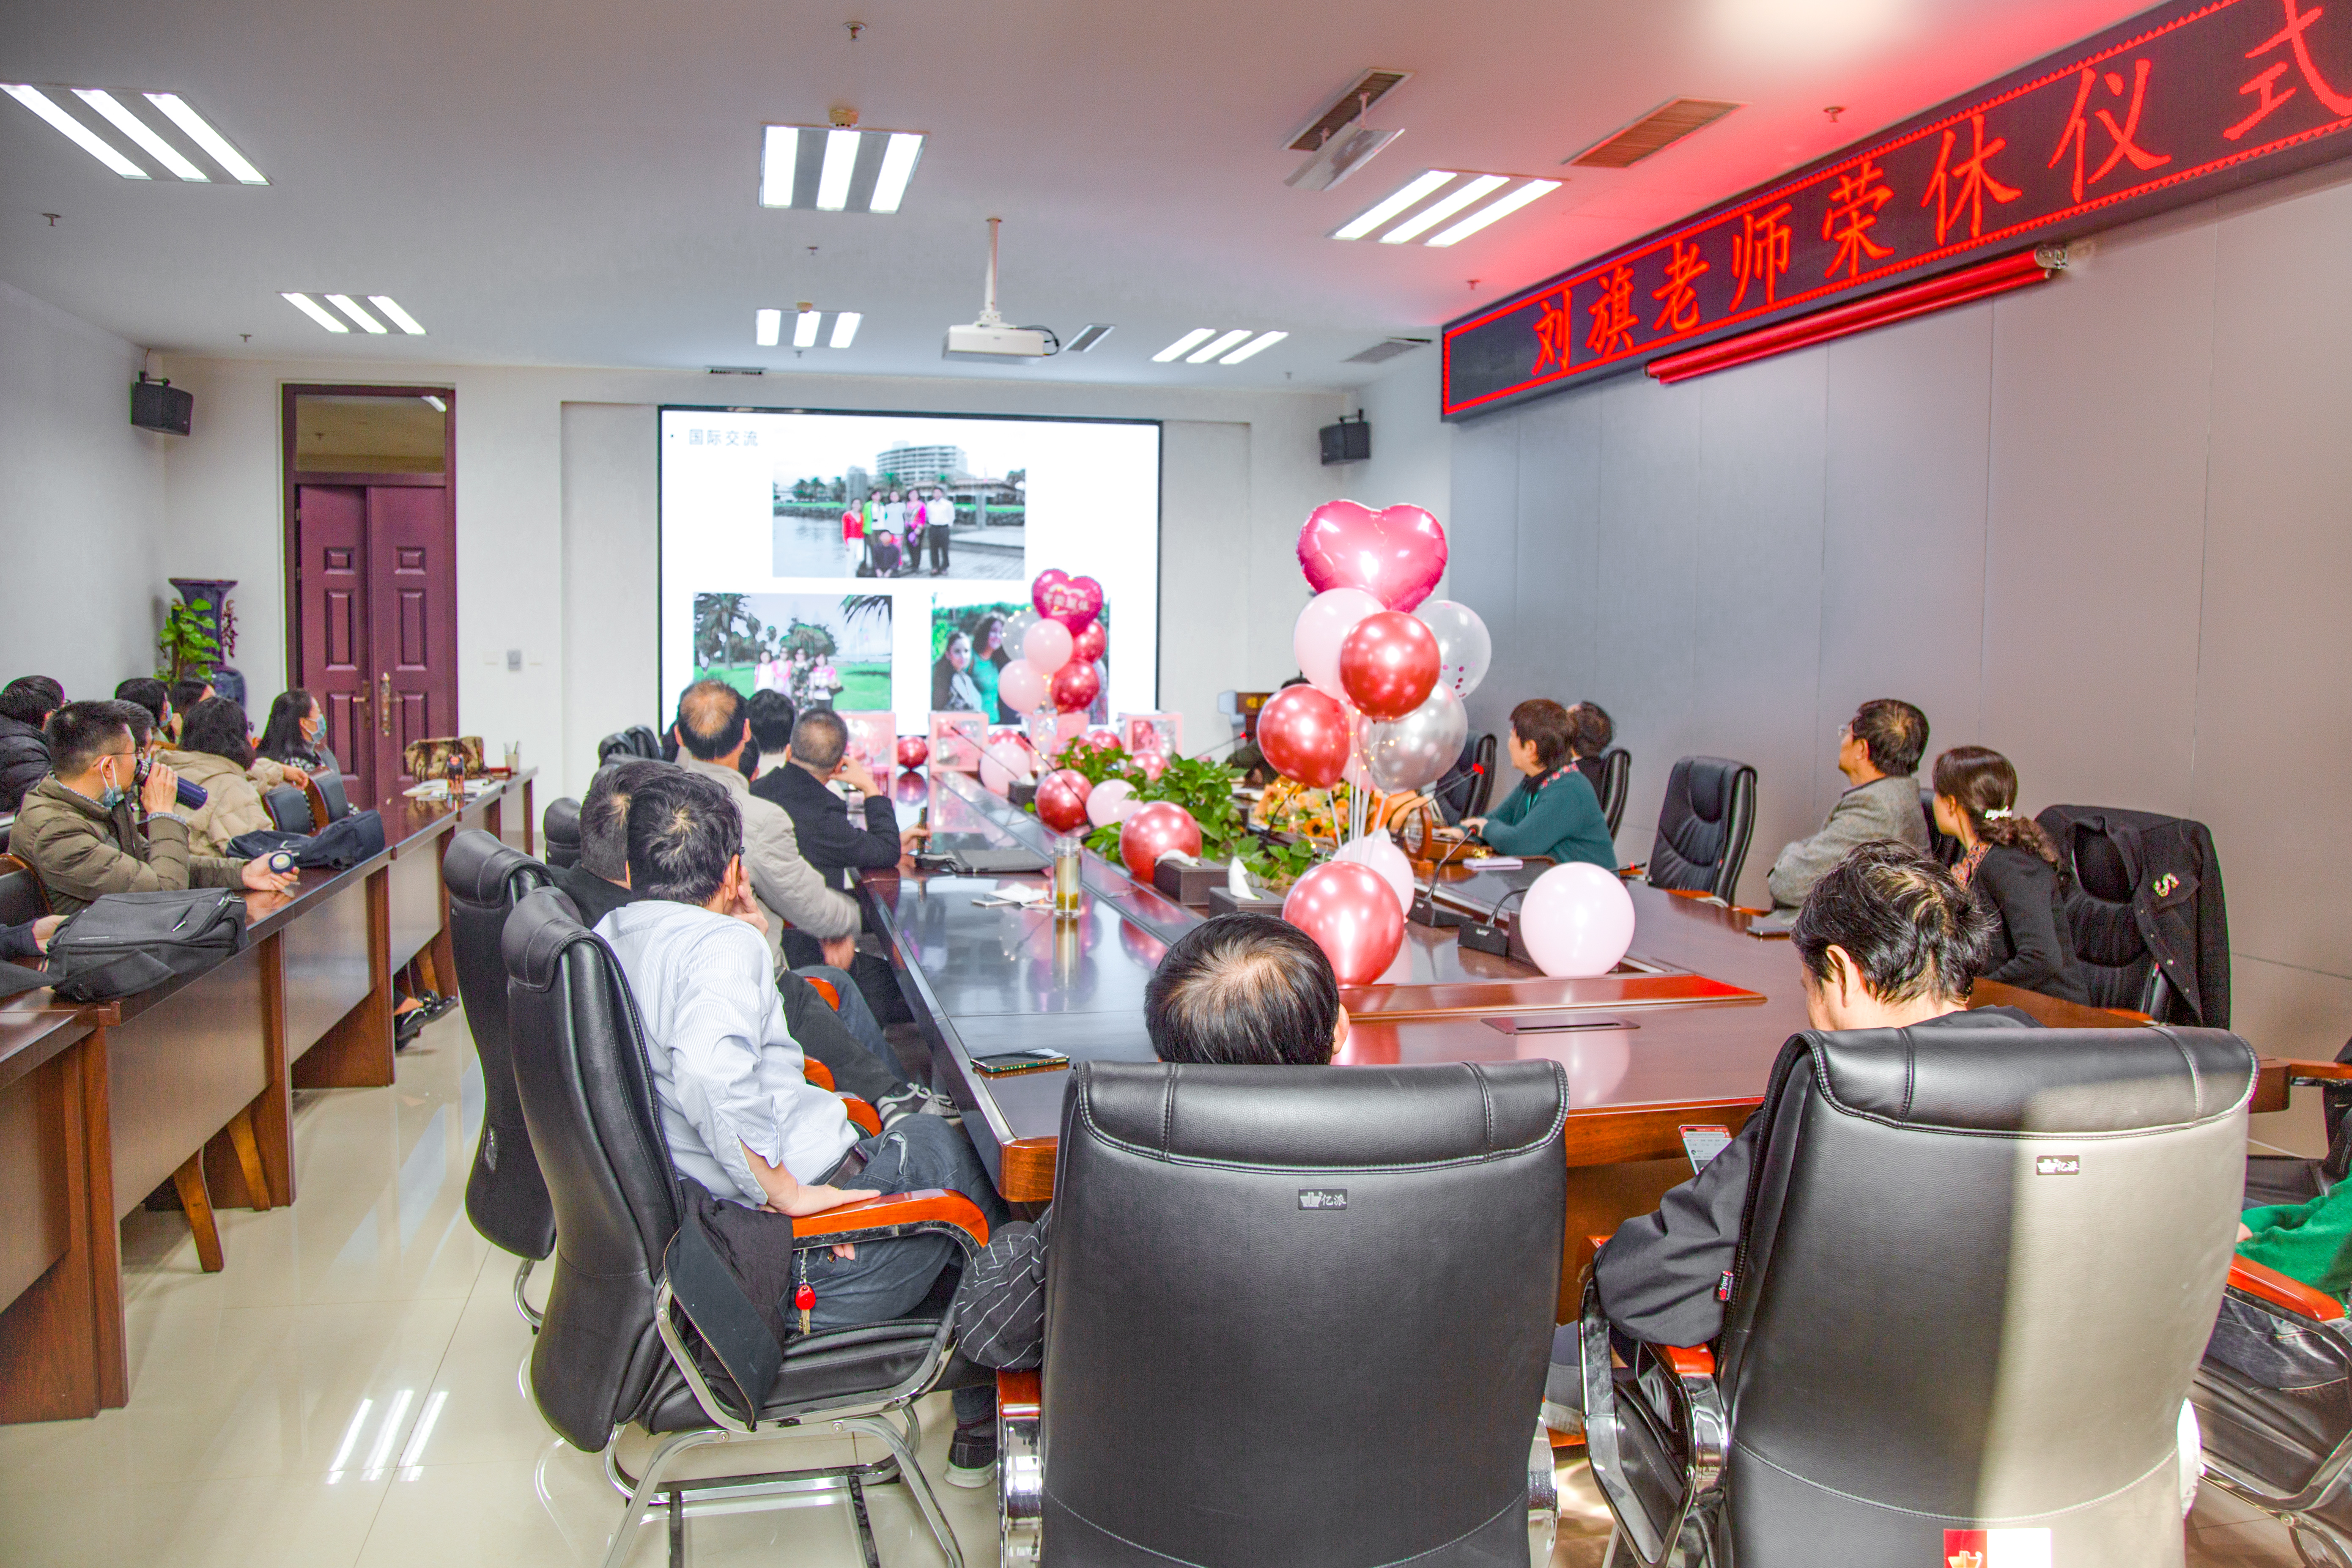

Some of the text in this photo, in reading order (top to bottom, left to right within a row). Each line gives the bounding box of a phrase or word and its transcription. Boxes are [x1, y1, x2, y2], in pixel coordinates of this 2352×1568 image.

[1531, 0, 2352, 376] 刘旗老师荣休仪式
[689, 429, 758, 446] 国际交流
[1321, 1194, 1346, 1206] 亿派
